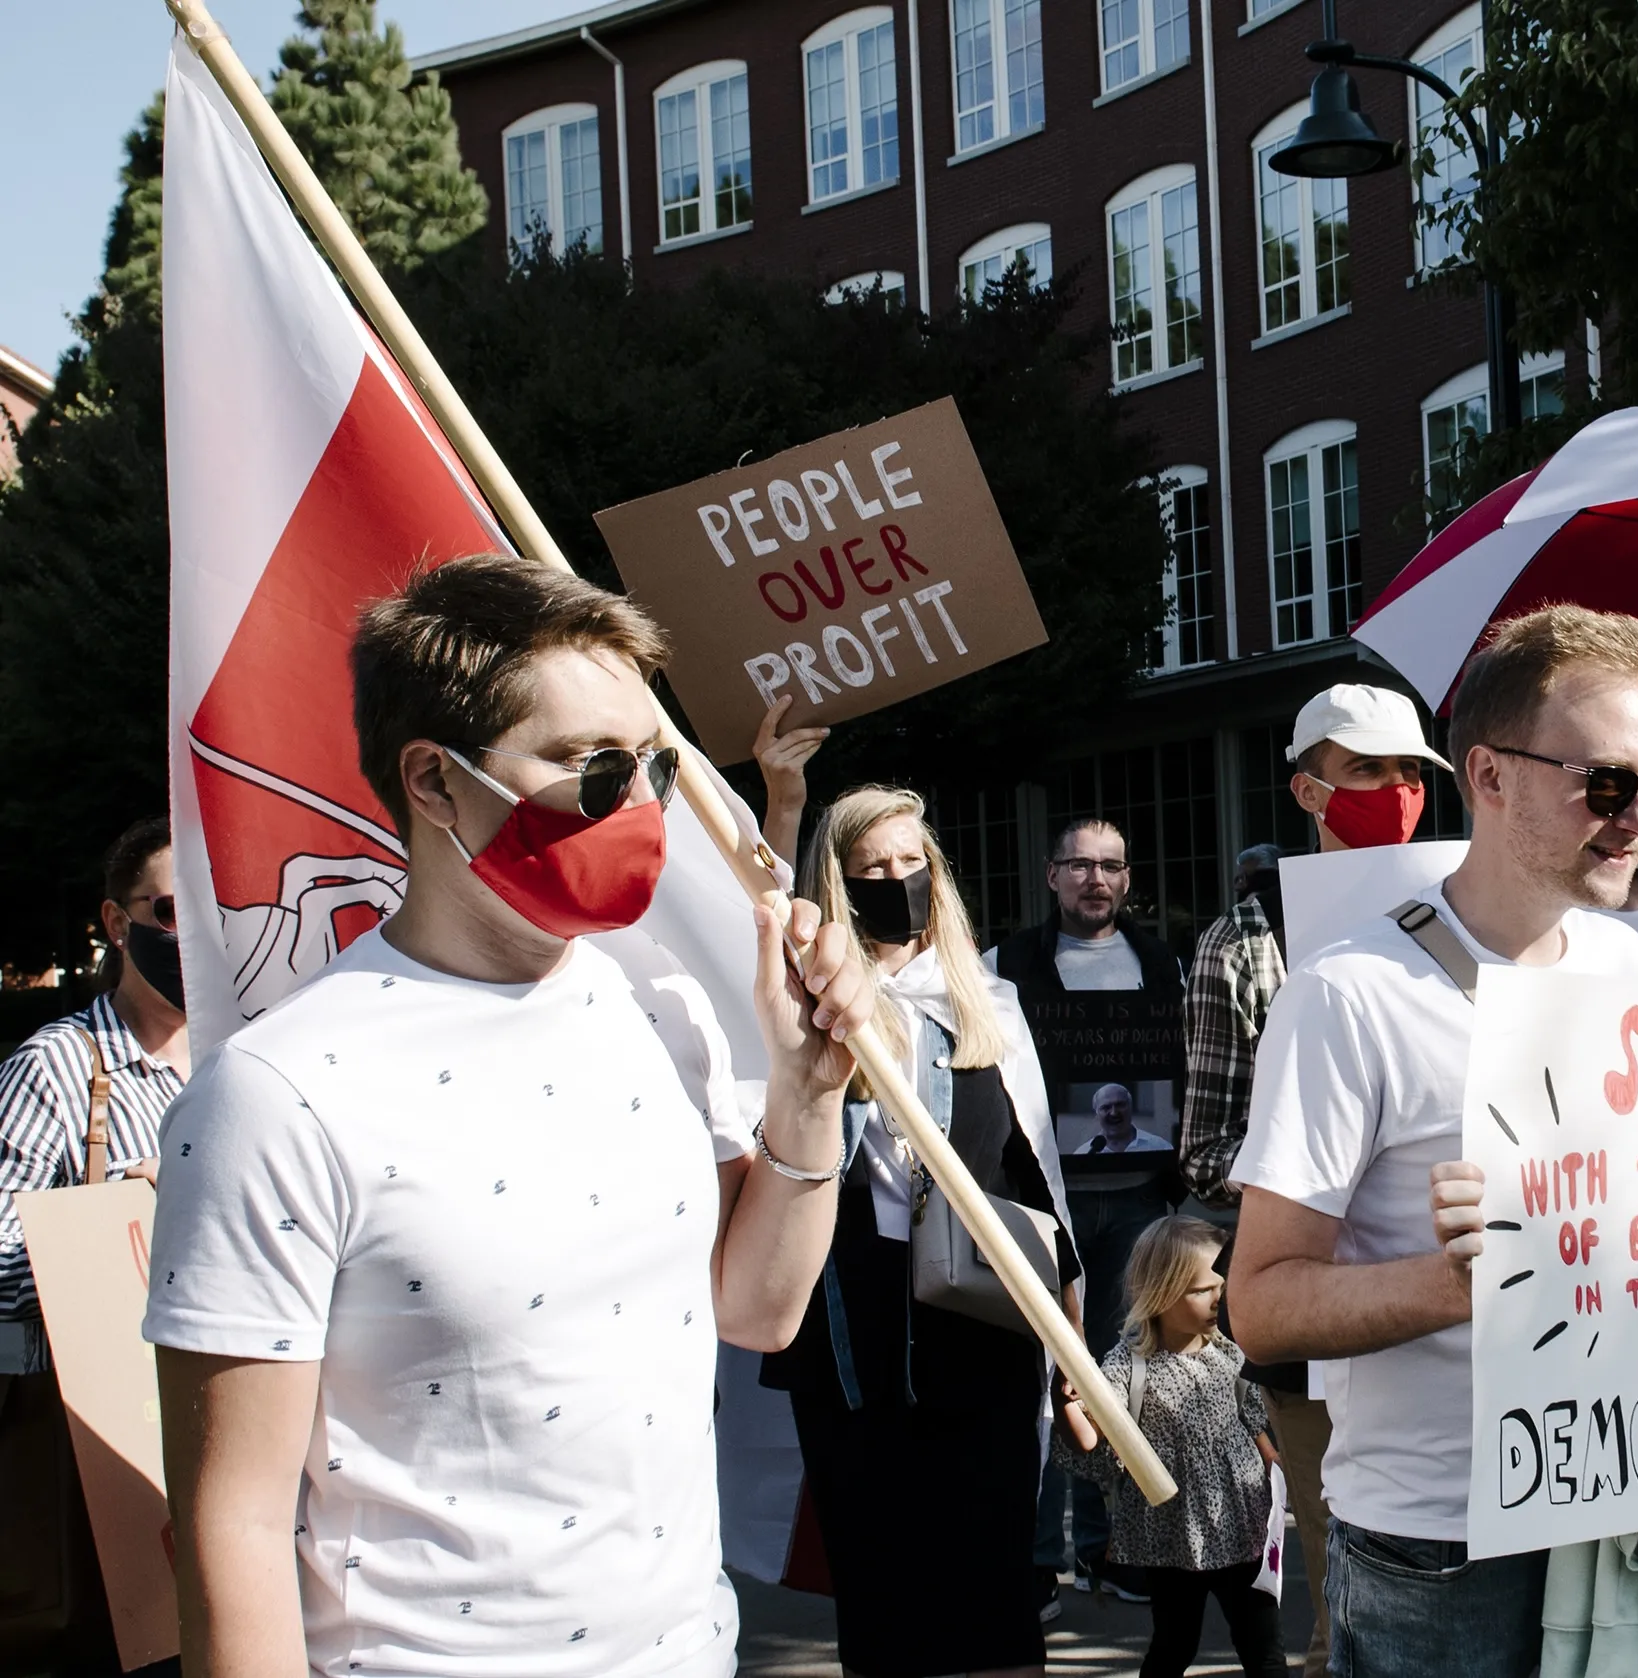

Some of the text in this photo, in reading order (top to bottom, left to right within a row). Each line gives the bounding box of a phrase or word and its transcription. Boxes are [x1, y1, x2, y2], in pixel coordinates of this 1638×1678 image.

[698, 441, 923, 568] PEOPLE
[757, 524, 930, 624] OVER
[743, 580, 968, 710] PROFIT
[1032, 1002, 1087, 1018] THIS
[1108, 1002, 1130, 1018] IS
[1051, 1027, 1105, 1047] YEARS
[1111, 1028, 1129, 1045] OF
[1130, 1052, 1171, 1066] LIKE
[1520, 1149, 1608, 1217] WITH
[1558, 1217, 1599, 1266] OF
[1575, 1280, 1602, 1315] IN
